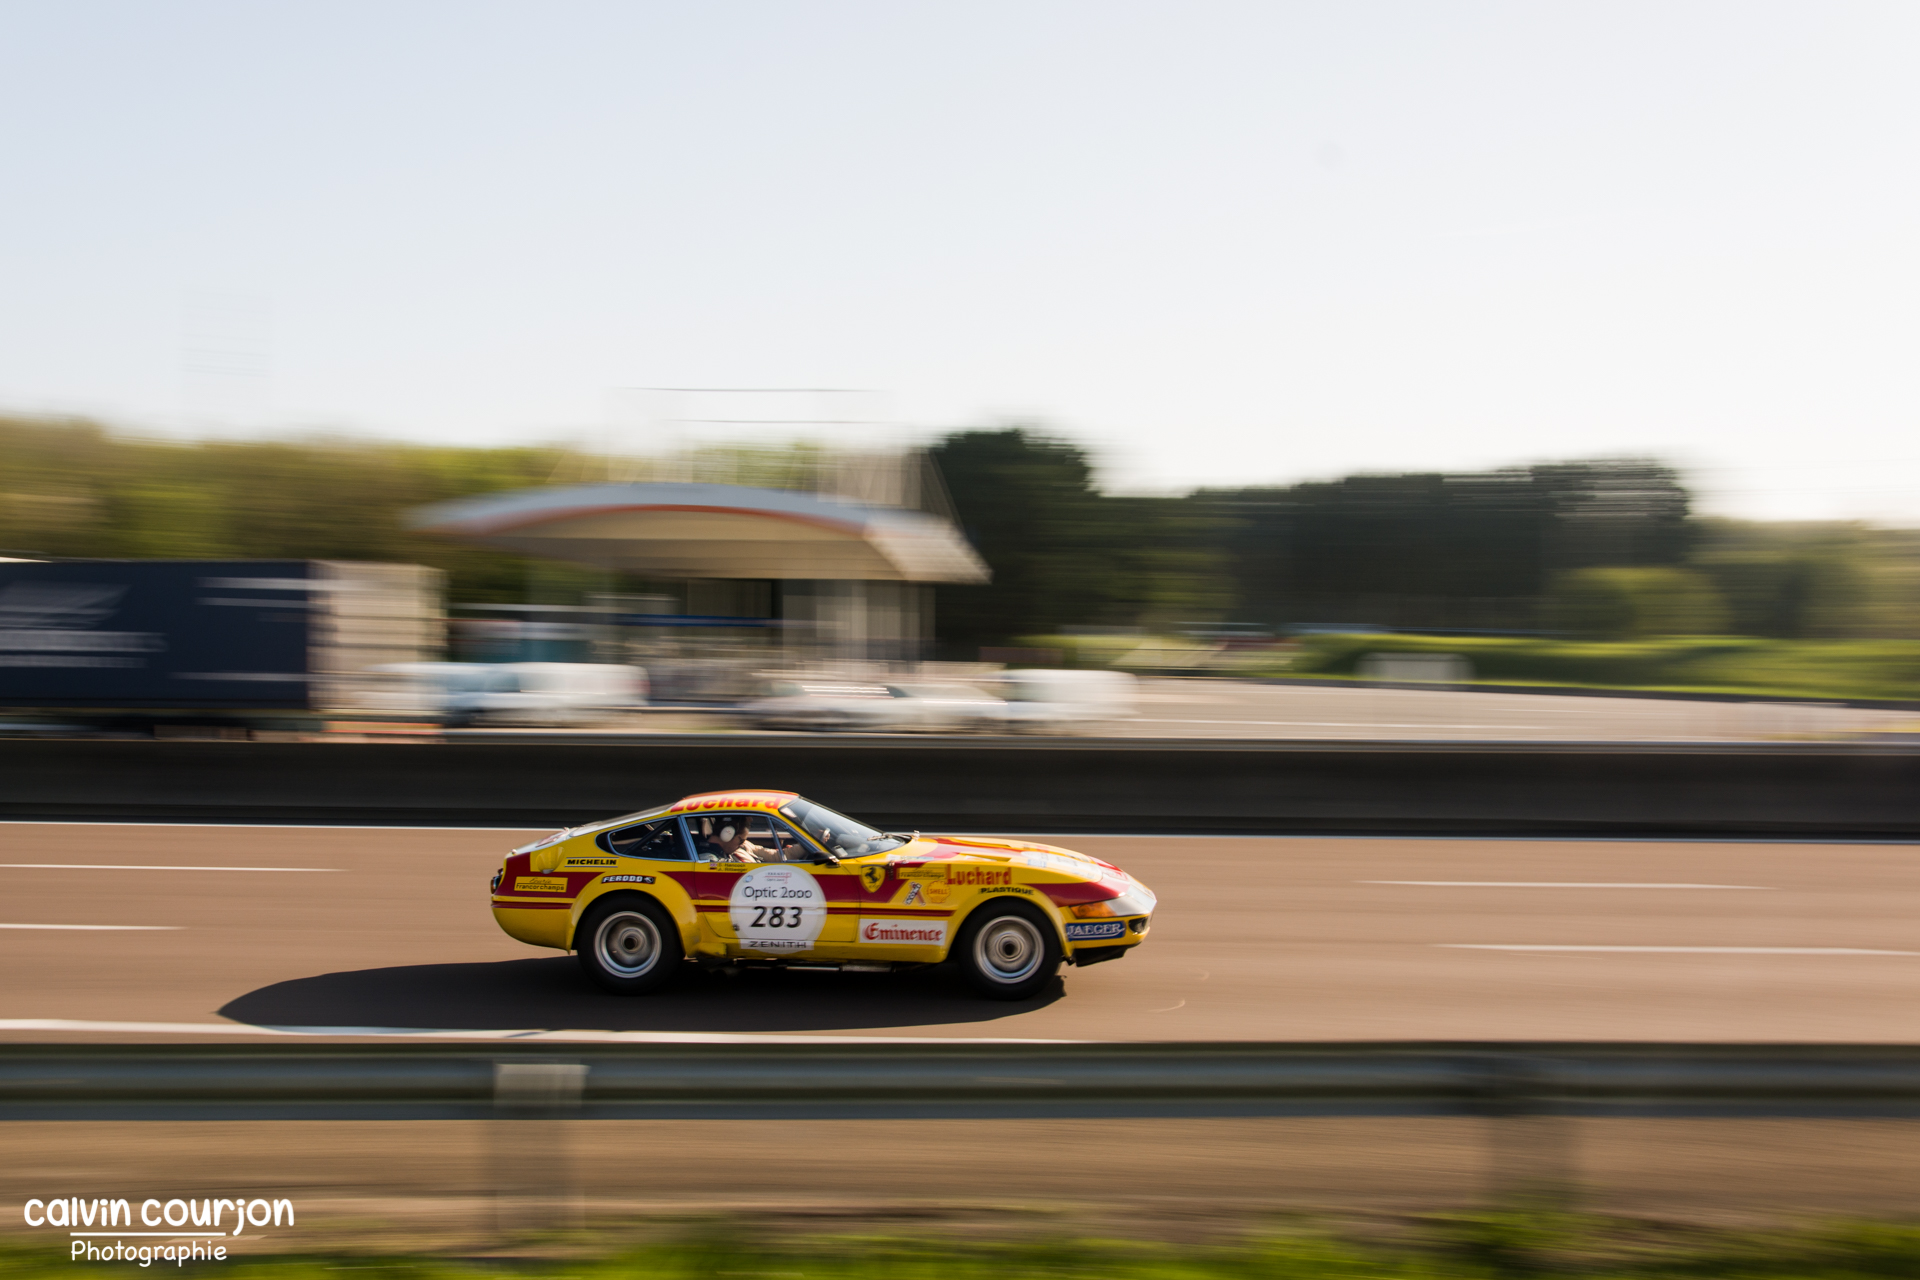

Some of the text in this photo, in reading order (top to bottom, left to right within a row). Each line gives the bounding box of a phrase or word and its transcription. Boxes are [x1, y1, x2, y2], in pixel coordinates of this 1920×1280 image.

[670, 797, 782, 812] Luchard
[603, 875, 643, 883] FERODO
[946, 864, 1012, 885] Luchard
[744, 886, 812, 901] Optic 2000
[980, 887, 1034, 895] PLASTIQUE
[750, 906, 803, 928] 283
[863, 922, 944, 941] Eminence
[1066, 922, 1124, 936] JAEGER
